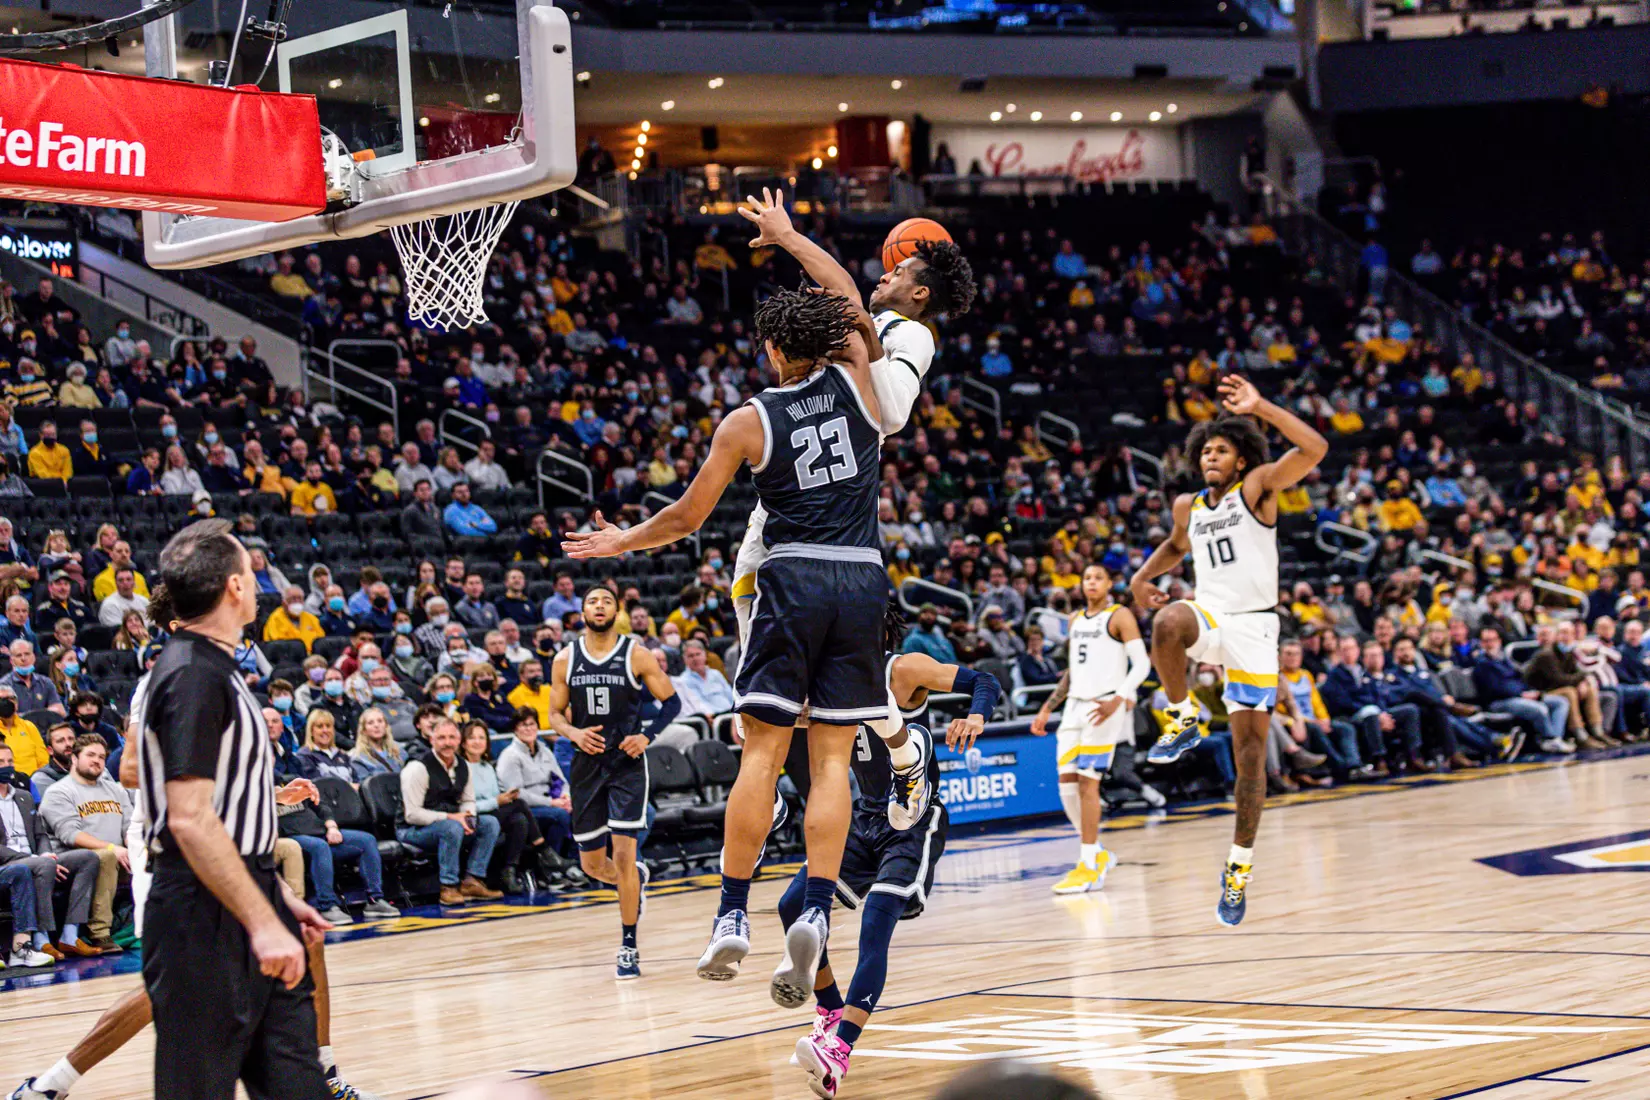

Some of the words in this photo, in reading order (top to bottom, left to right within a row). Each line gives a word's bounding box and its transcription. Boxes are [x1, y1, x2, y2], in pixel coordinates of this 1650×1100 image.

[785, 393, 836, 422] HOLLOWAY
[790, 416, 858, 490] 23
[1206, 536, 1236, 569] 10
[1078, 643, 1088, 664] 5
[571, 674, 626, 687] GEORGETOWN
[585, 686, 611, 715] 13
[938, 772, 1018, 805] GRUBER
